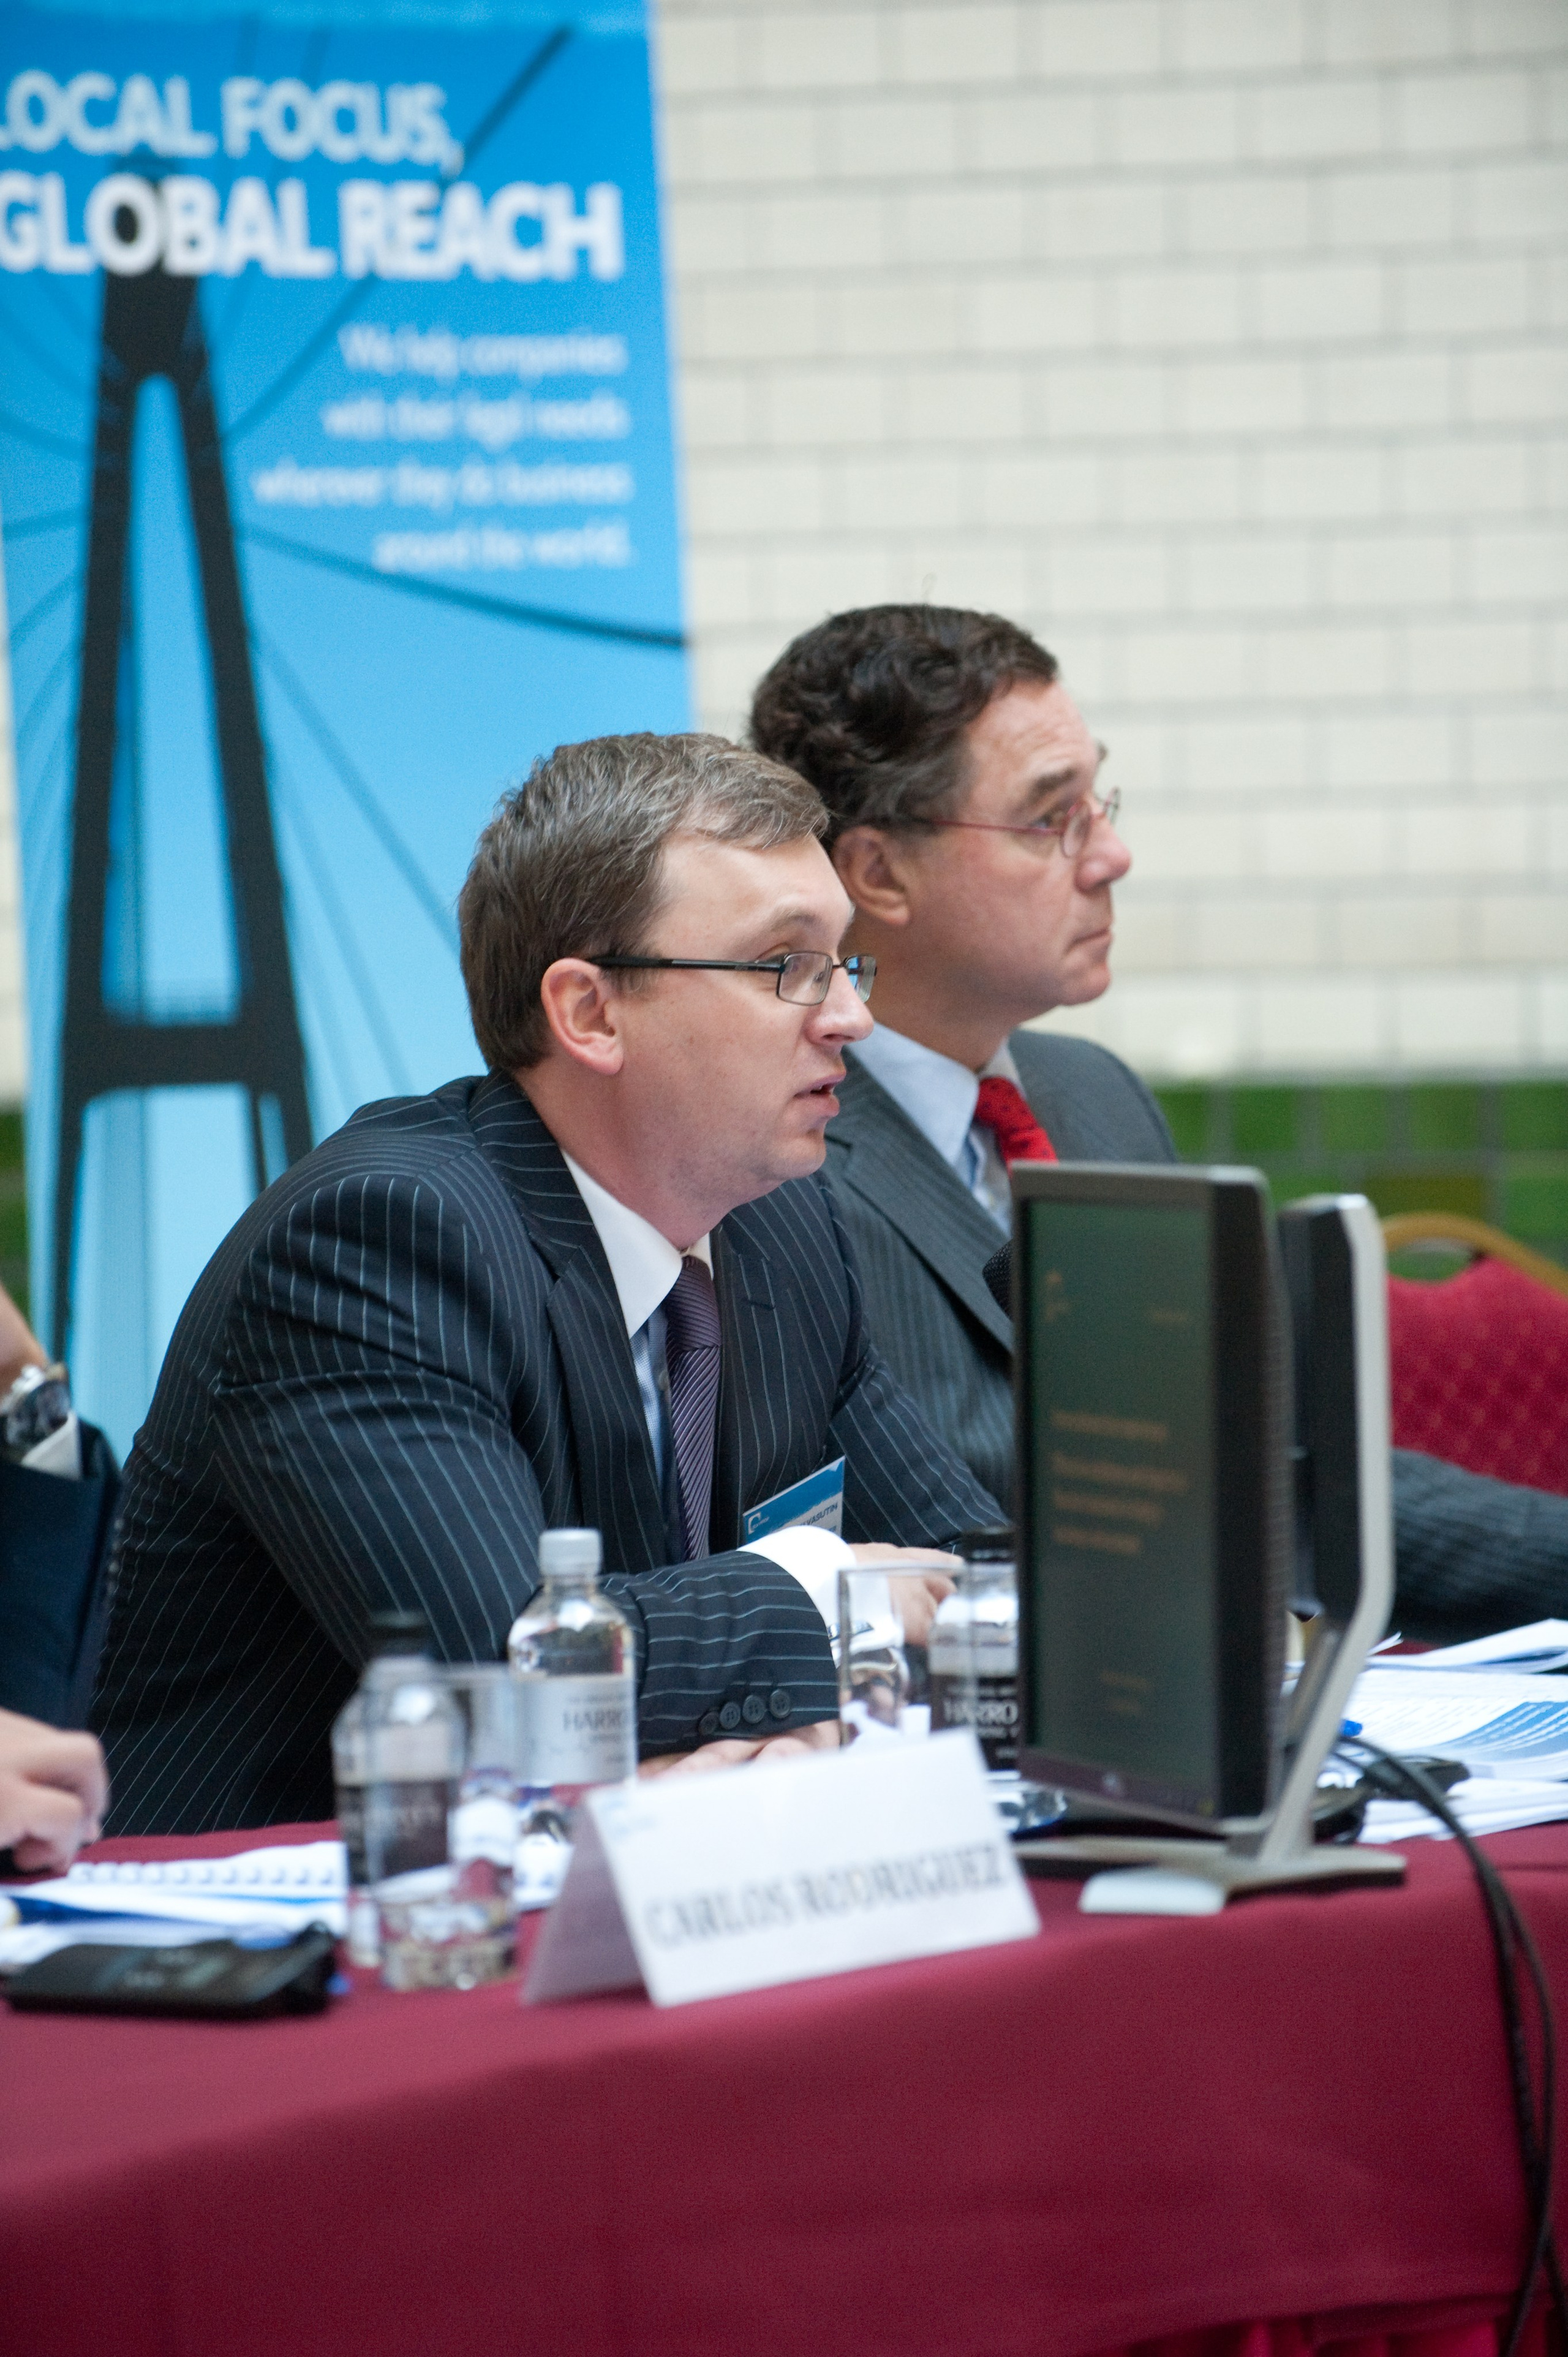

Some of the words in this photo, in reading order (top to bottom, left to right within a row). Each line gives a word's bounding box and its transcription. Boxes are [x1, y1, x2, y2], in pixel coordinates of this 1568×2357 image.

[0, 69, 217, 157] OCAL
[221, 77, 464, 179] FOCUS,
[0, 170, 336, 279] GLOBAL
[338, 179, 624, 282] REACH
[644, 1880, 795, 1949] CARLOS
[794, 1841, 1008, 1918] RODRIGUEZ
